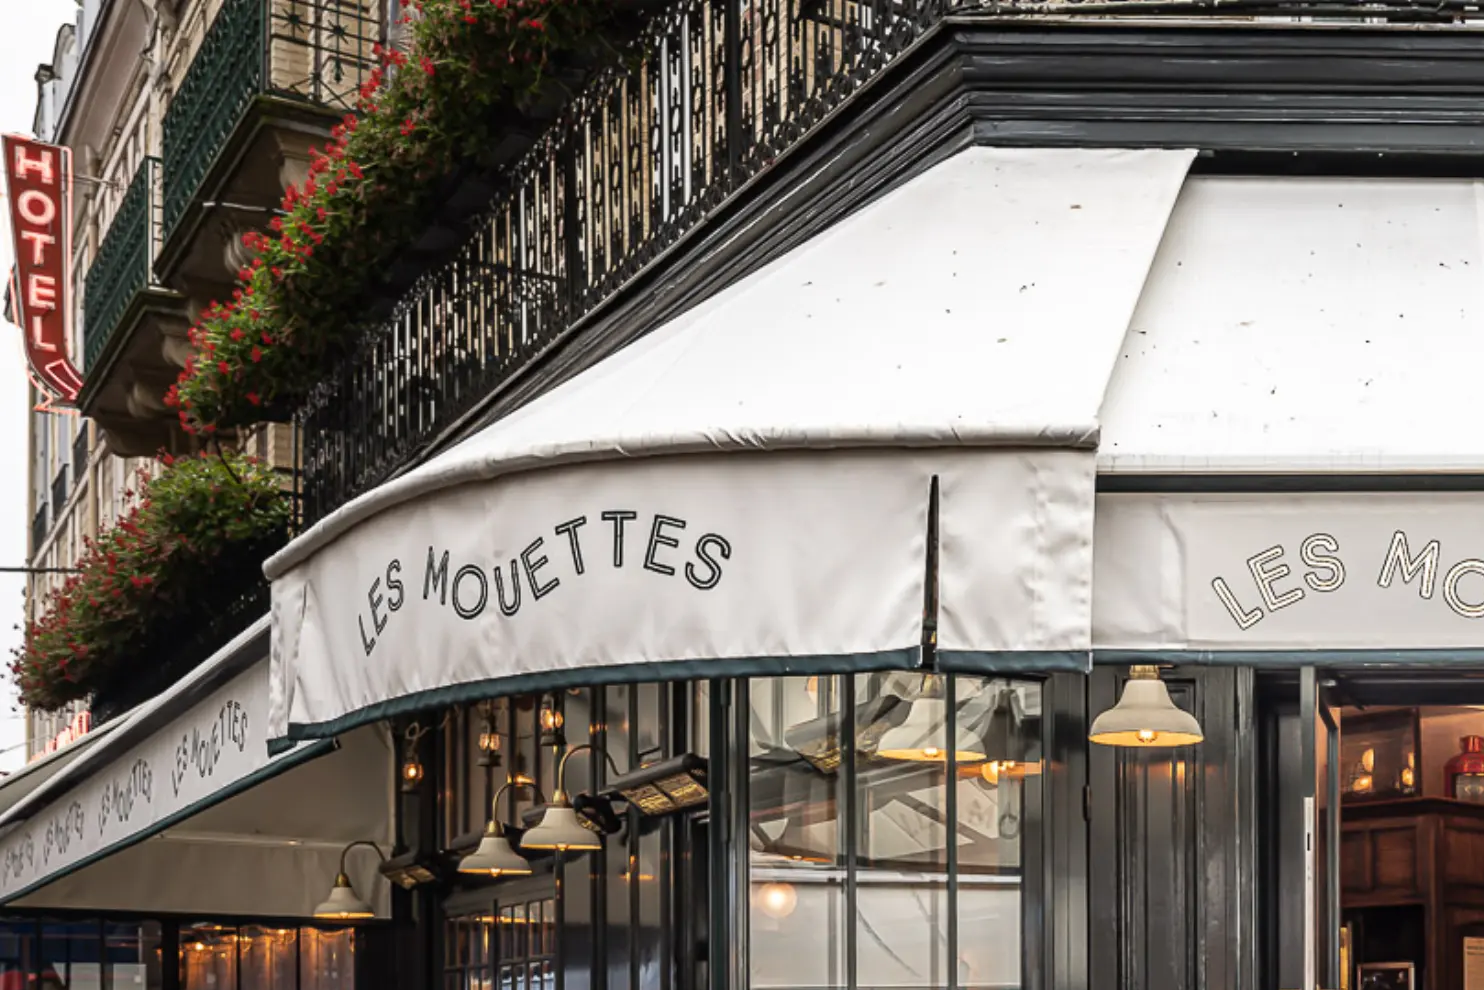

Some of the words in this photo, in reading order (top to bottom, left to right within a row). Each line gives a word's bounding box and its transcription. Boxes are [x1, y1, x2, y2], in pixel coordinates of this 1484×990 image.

[15, 145, 57, 352] HOTEL
[358, 558, 404, 656] LES
[423, 510, 732, 620] MOUETTES
[1212, 532, 1345, 629] LES
[171, 734, 188, 798] LES
[191, 700, 248, 778] MOUETTES
